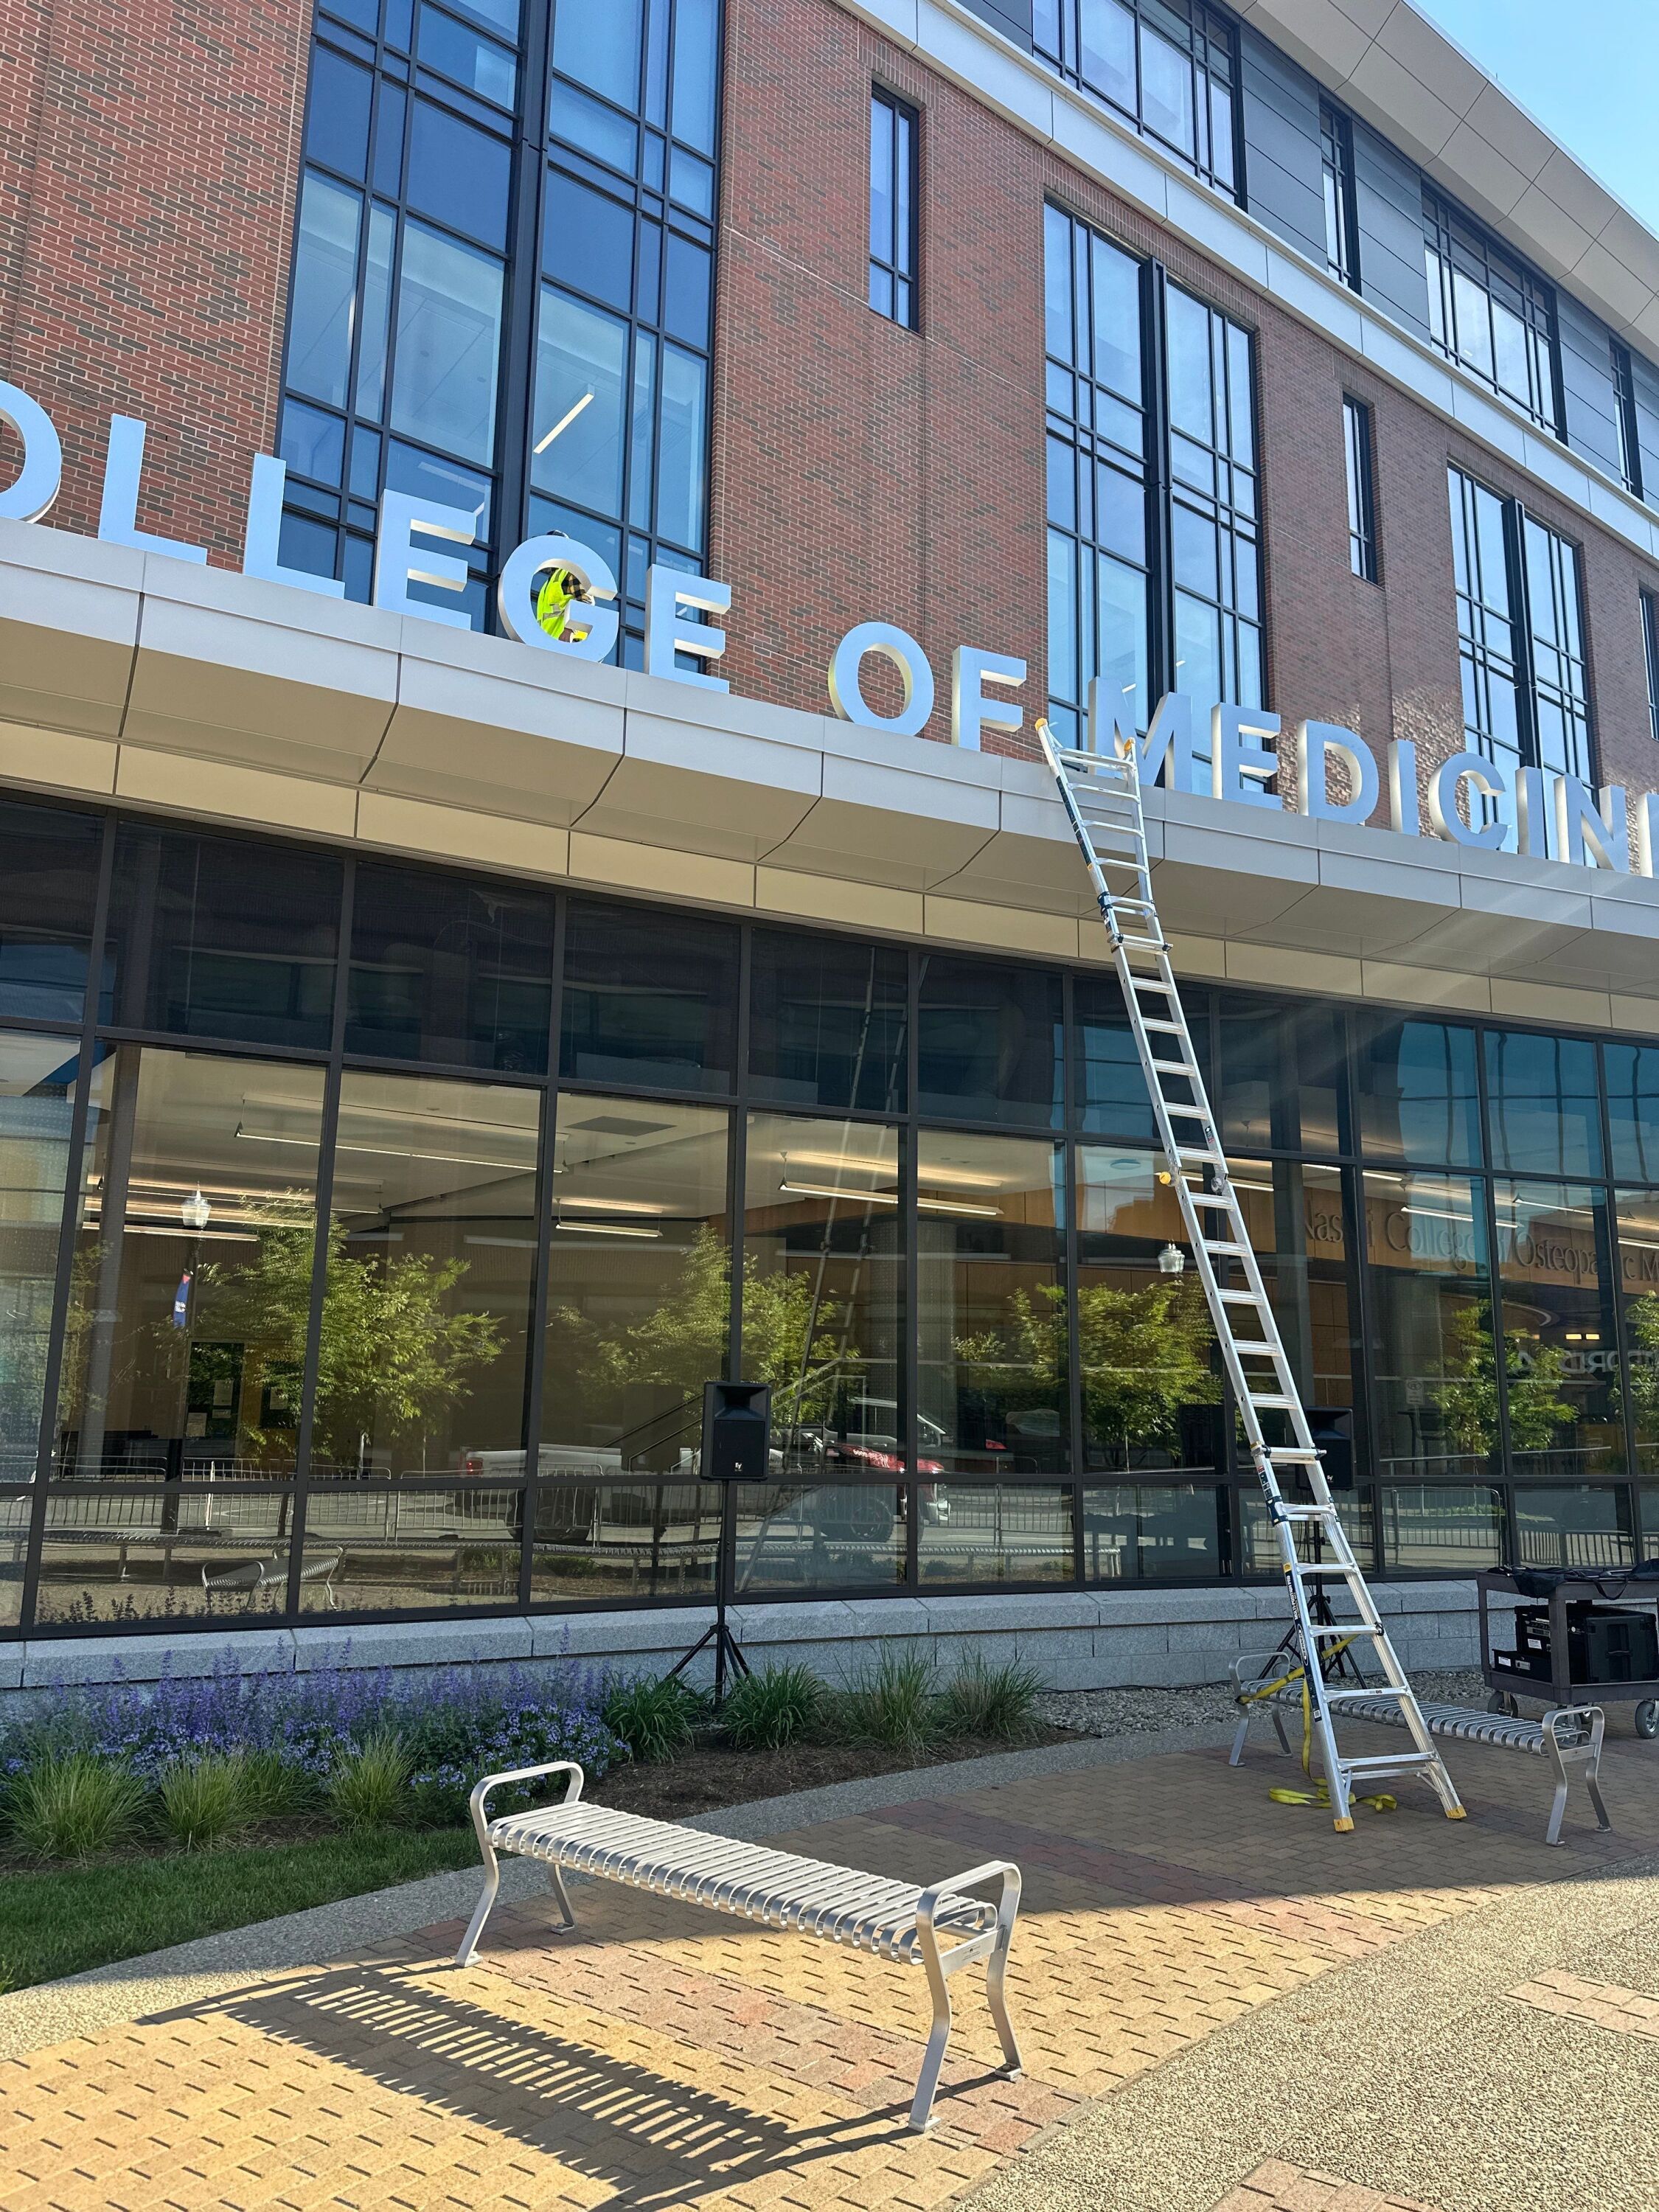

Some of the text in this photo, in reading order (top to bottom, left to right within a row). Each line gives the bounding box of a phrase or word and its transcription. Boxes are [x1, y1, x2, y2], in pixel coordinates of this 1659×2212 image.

[828, 621, 1027, 752] OF
[1304, 1199, 1374, 1248] Nasi
[1515, 1232, 1635, 1284] Osteopac
